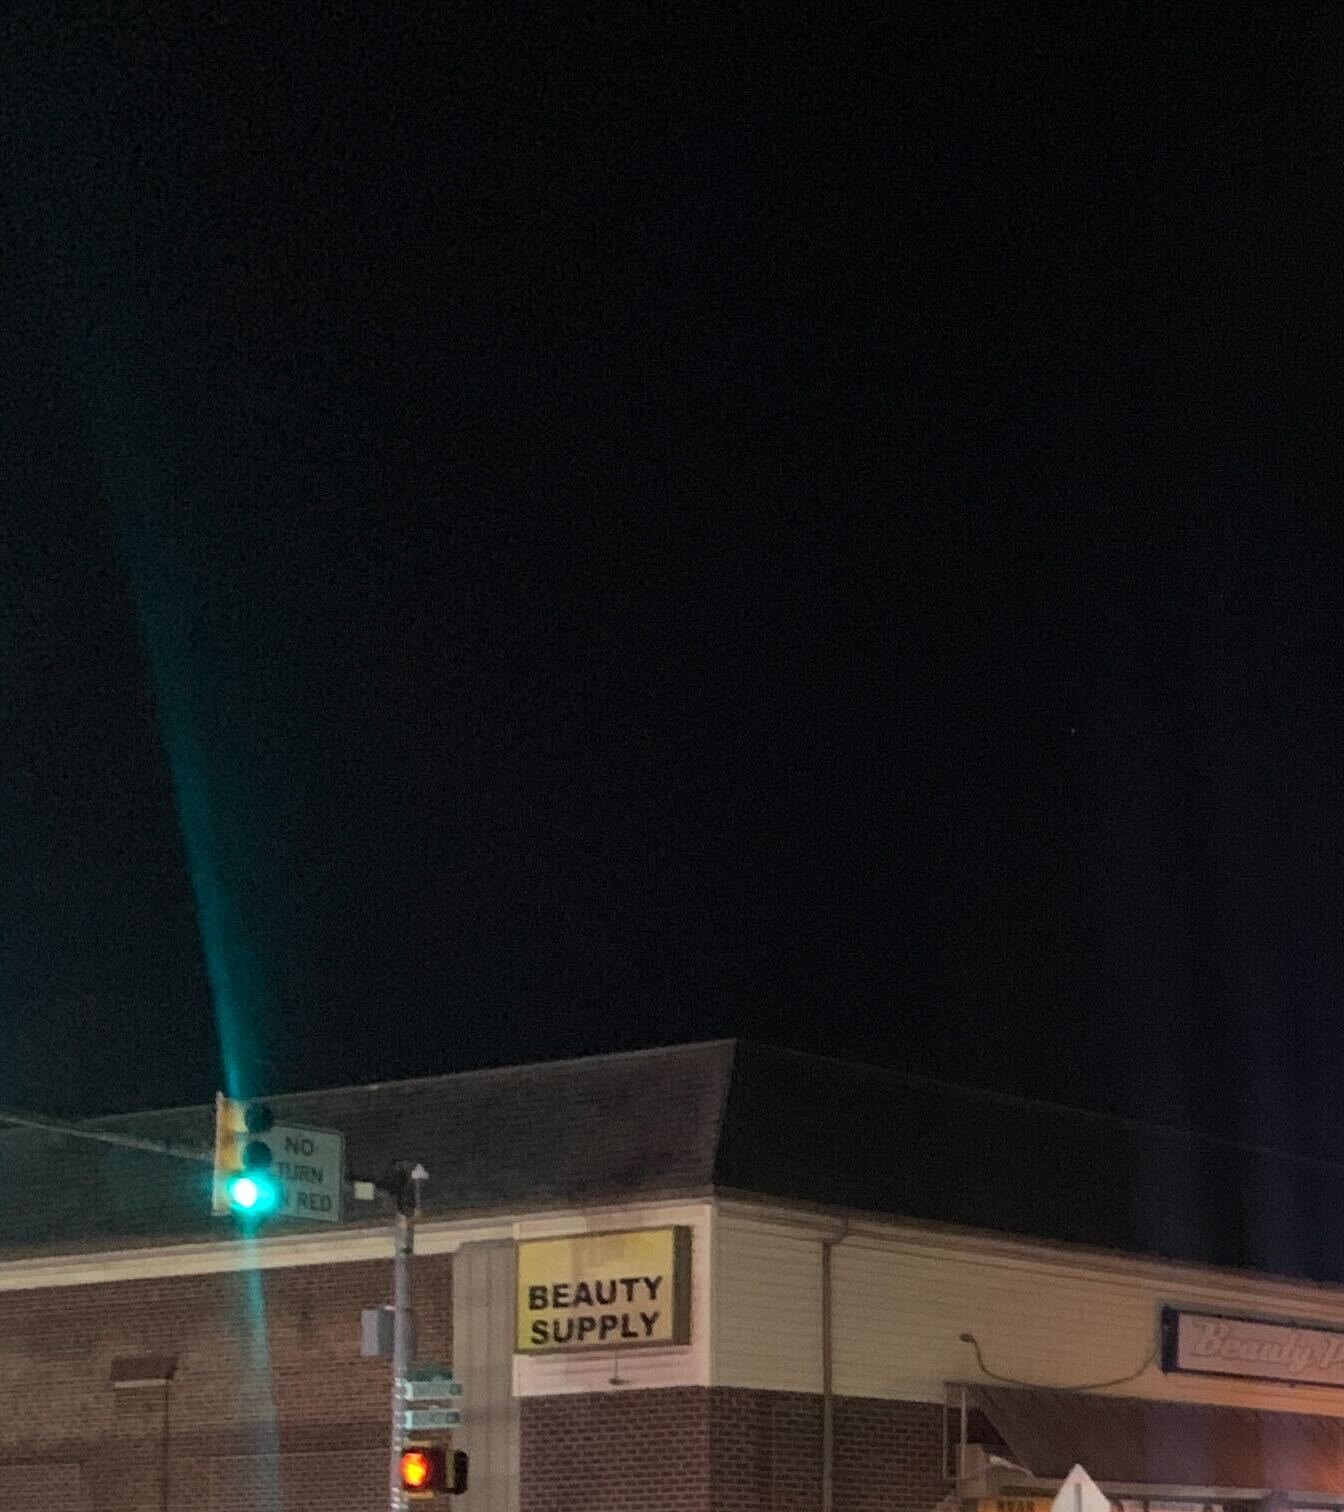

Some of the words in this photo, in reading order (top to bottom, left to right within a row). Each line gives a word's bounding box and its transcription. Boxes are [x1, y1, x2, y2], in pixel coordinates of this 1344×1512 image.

[284, 1137, 314, 1157] NO
[297, 1192, 332, 1212] RED
[528, 1275, 662, 1311] BEAUTY
[530, 1312, 660, 1345] SUPPLY
